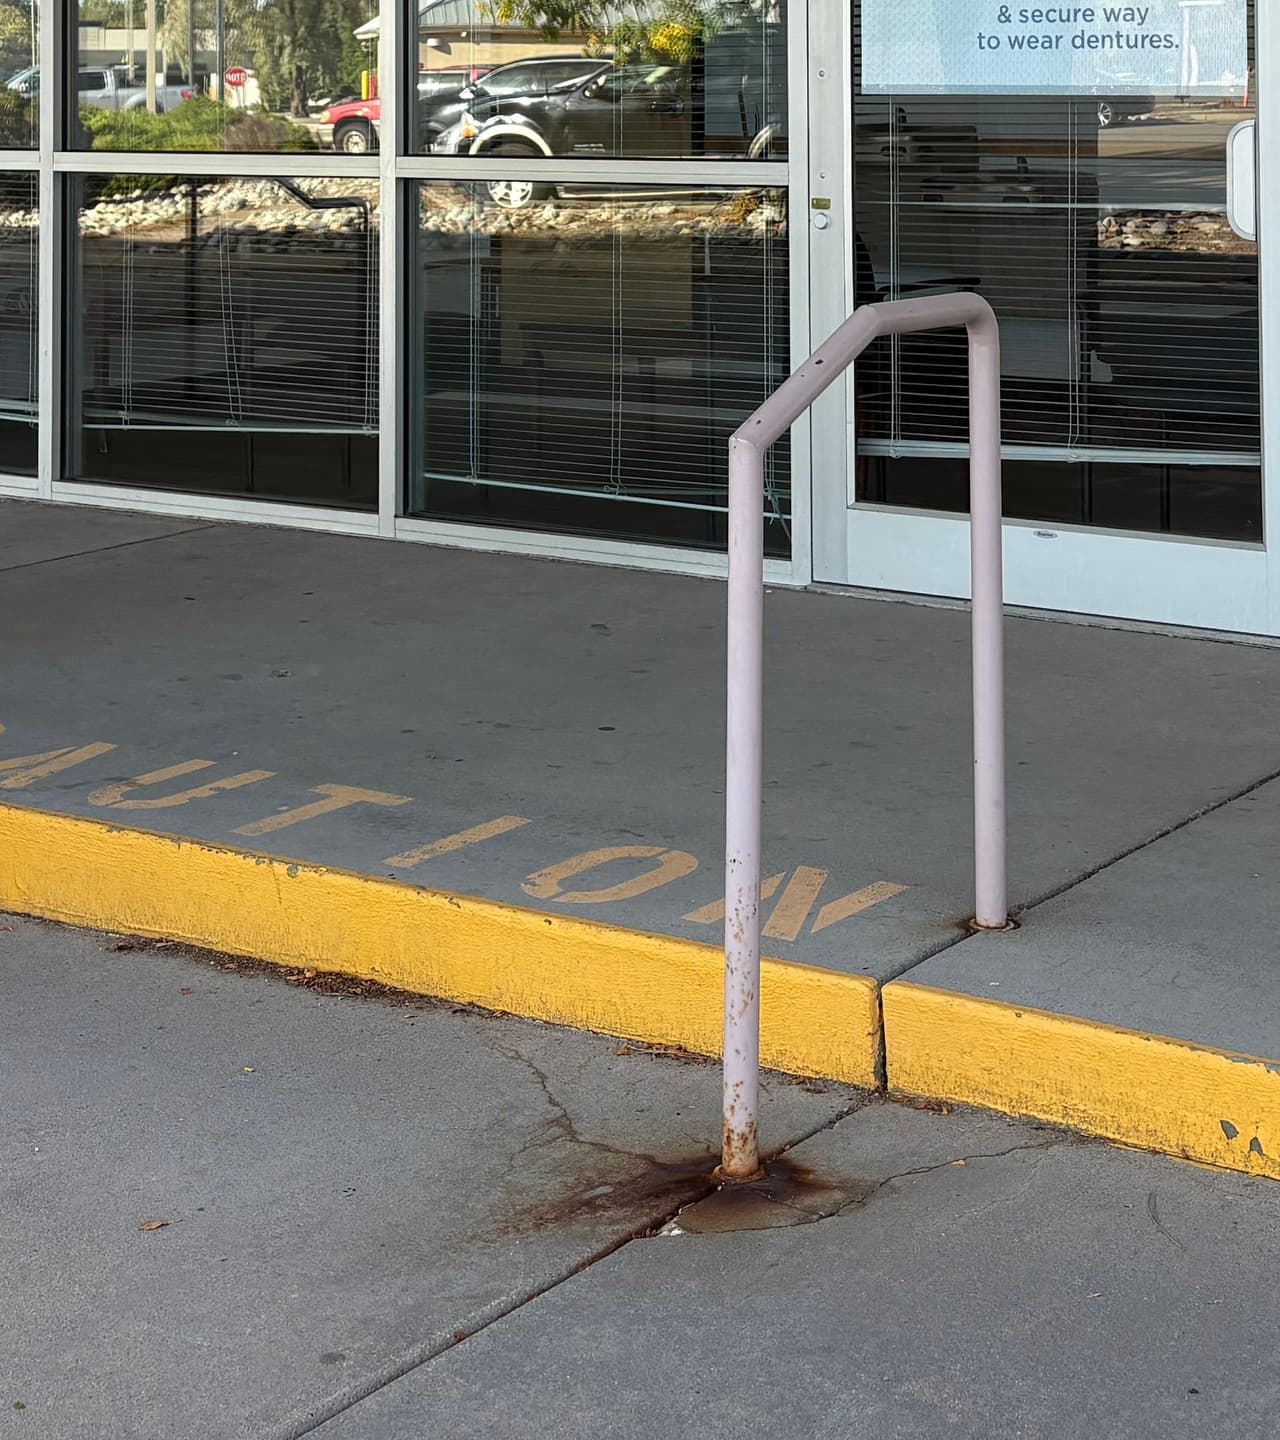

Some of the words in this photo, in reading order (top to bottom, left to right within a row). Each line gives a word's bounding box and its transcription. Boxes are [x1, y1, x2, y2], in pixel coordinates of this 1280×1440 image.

[997, 4, 1012, 24] &
[1018, 6, 1096, 24] secure
[1102, 6, 1150, 27] way
[977, 31, 1001, 50] to
[1007, 33, 1064, 50] wear
[1071, 29, 1180, 50] dentures.
